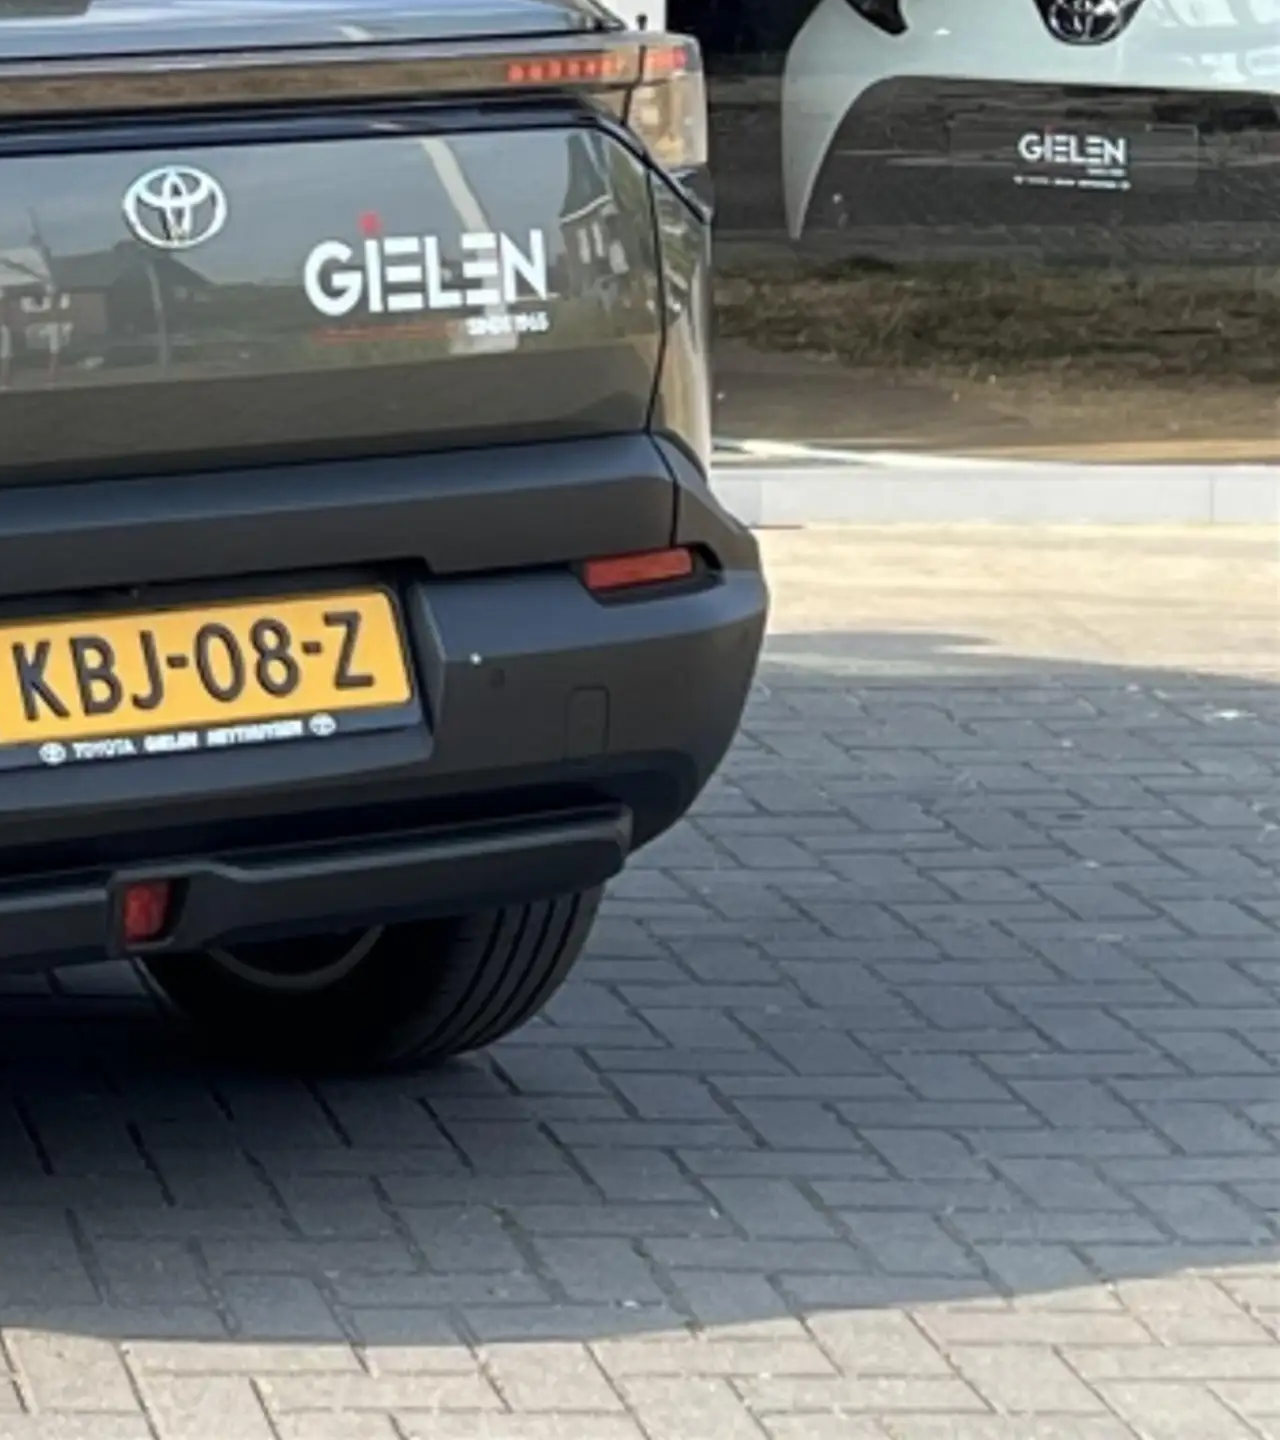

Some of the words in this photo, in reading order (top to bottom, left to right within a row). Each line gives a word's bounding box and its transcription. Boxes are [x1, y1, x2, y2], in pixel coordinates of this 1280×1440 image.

[1017, 125, 1128, 165] GIELEN
[303, 211, 549, 317] GIELEN
[12, 610, 374, 722] KBJ-08-Z
[72, 738, 138, 760] TOYOTA
